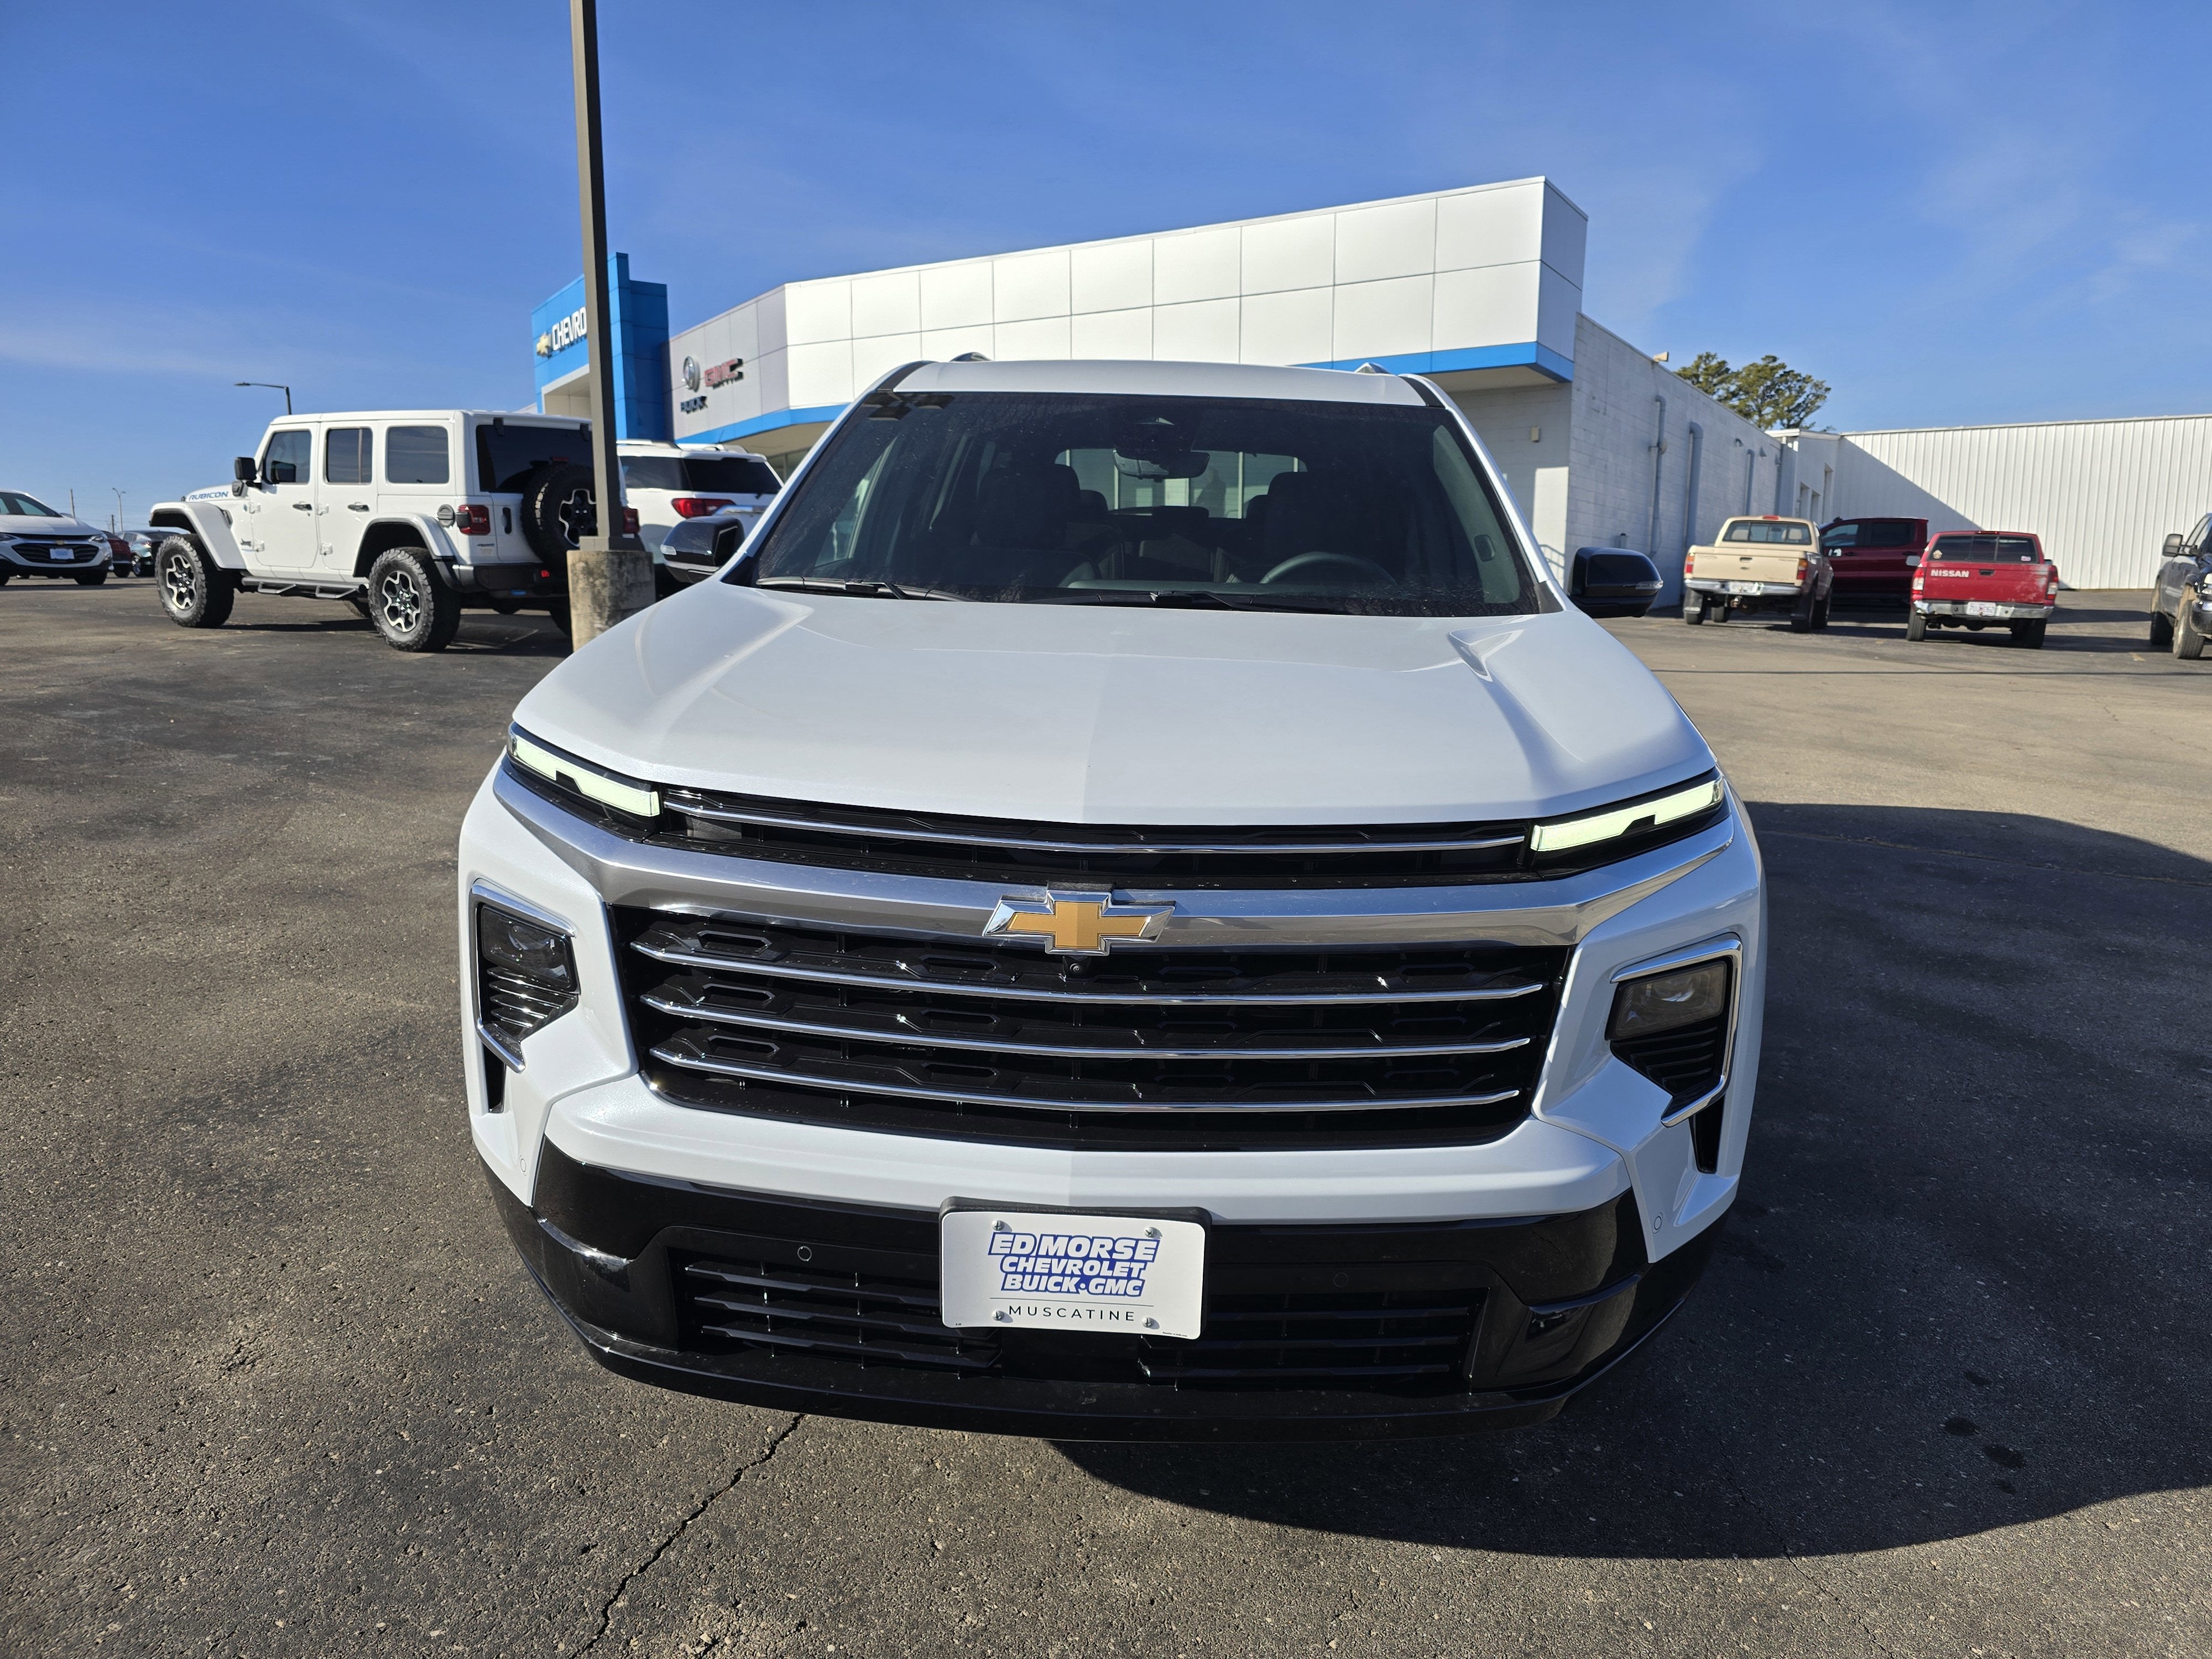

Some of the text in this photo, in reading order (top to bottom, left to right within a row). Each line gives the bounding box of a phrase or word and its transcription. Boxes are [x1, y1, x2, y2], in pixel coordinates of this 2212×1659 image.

[704, 358, 742, 388] GMC
[189, 491, 229, 500] RUBICON
[989, 1233, 1159, 1261] ED MORSE
[1001, 1256, 1145, 1278] CHEVROLET
[1009, 1306, 1134, 1321] MUSCATINE
